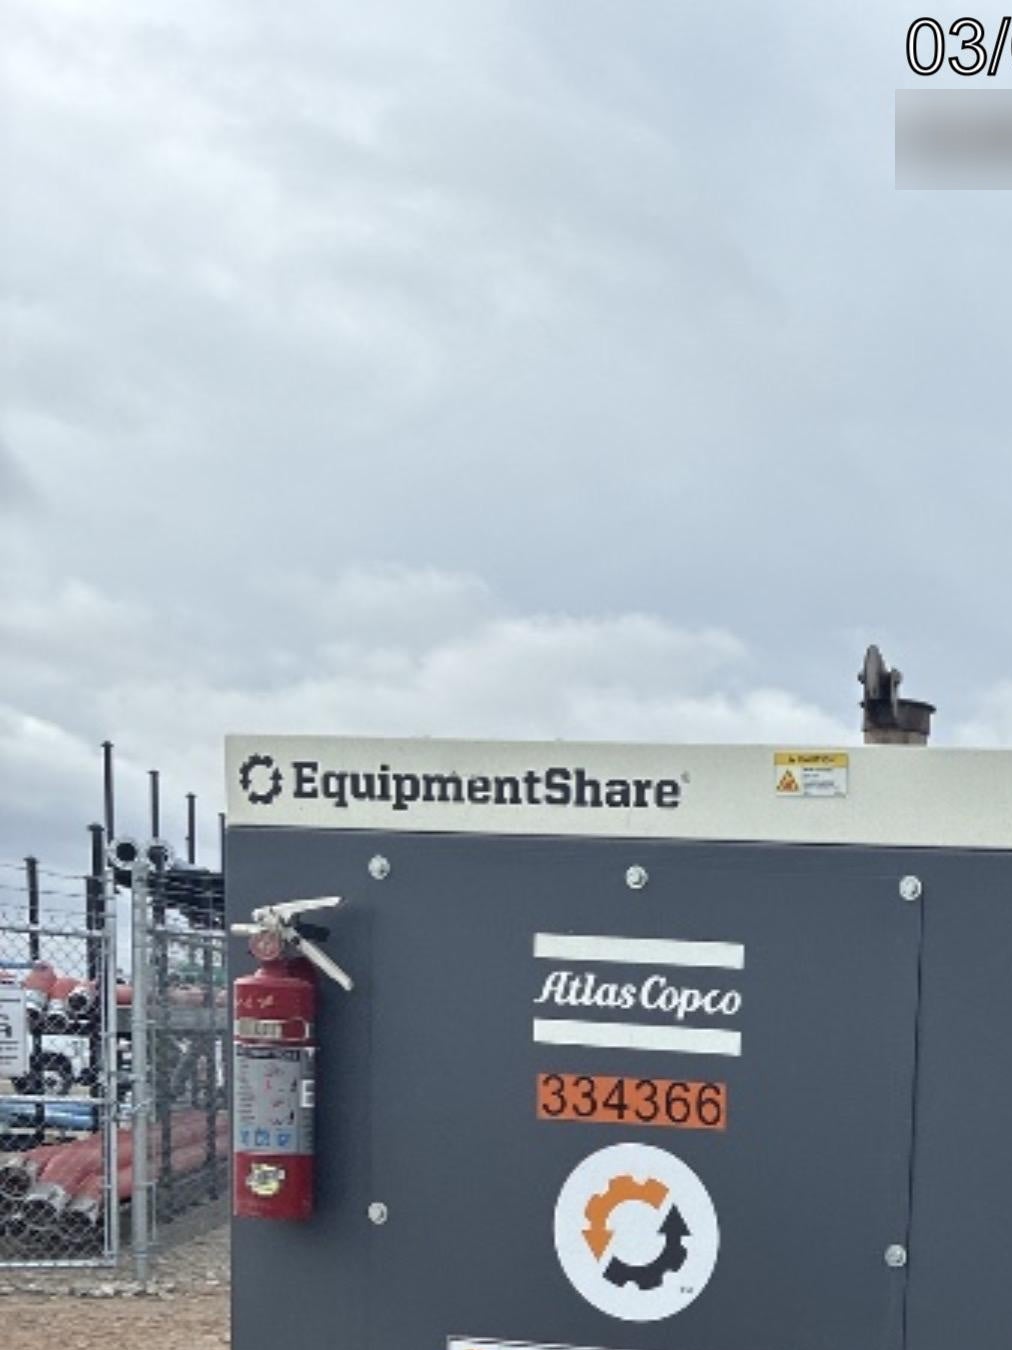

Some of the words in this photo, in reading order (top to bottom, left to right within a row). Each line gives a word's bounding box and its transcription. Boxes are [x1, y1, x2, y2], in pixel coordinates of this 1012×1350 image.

[292, 761, 683, 811] EquipmentShare
[533, 971, 637, 1010] Atlas
[640, 974, 742, 1021] Copco
[541, 1073, 722, 1126] 334366
